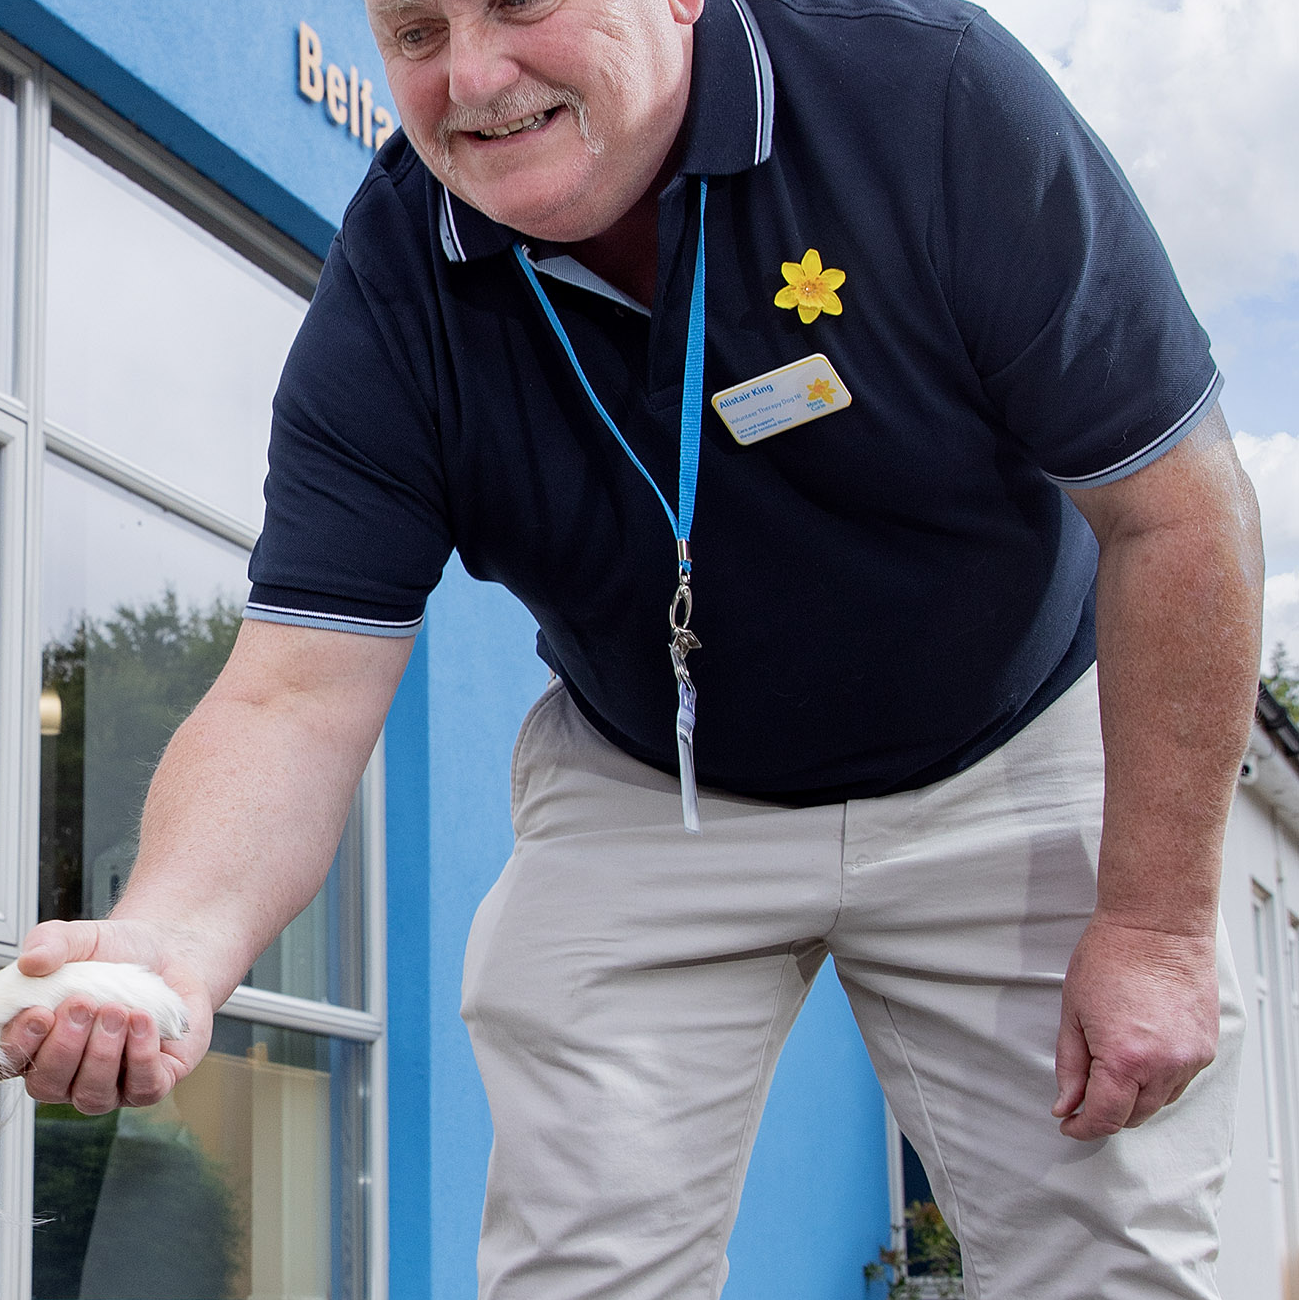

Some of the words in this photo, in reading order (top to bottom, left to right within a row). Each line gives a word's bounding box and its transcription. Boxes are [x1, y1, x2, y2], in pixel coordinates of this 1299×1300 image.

[719, 392, 750, 409] Alistair
[751, 384, 774, 397] King
[729, 411, 757, 424] Volunteer
[757, 401, 782, 414] Therapy
[781, 396, 795, 404] Dog
